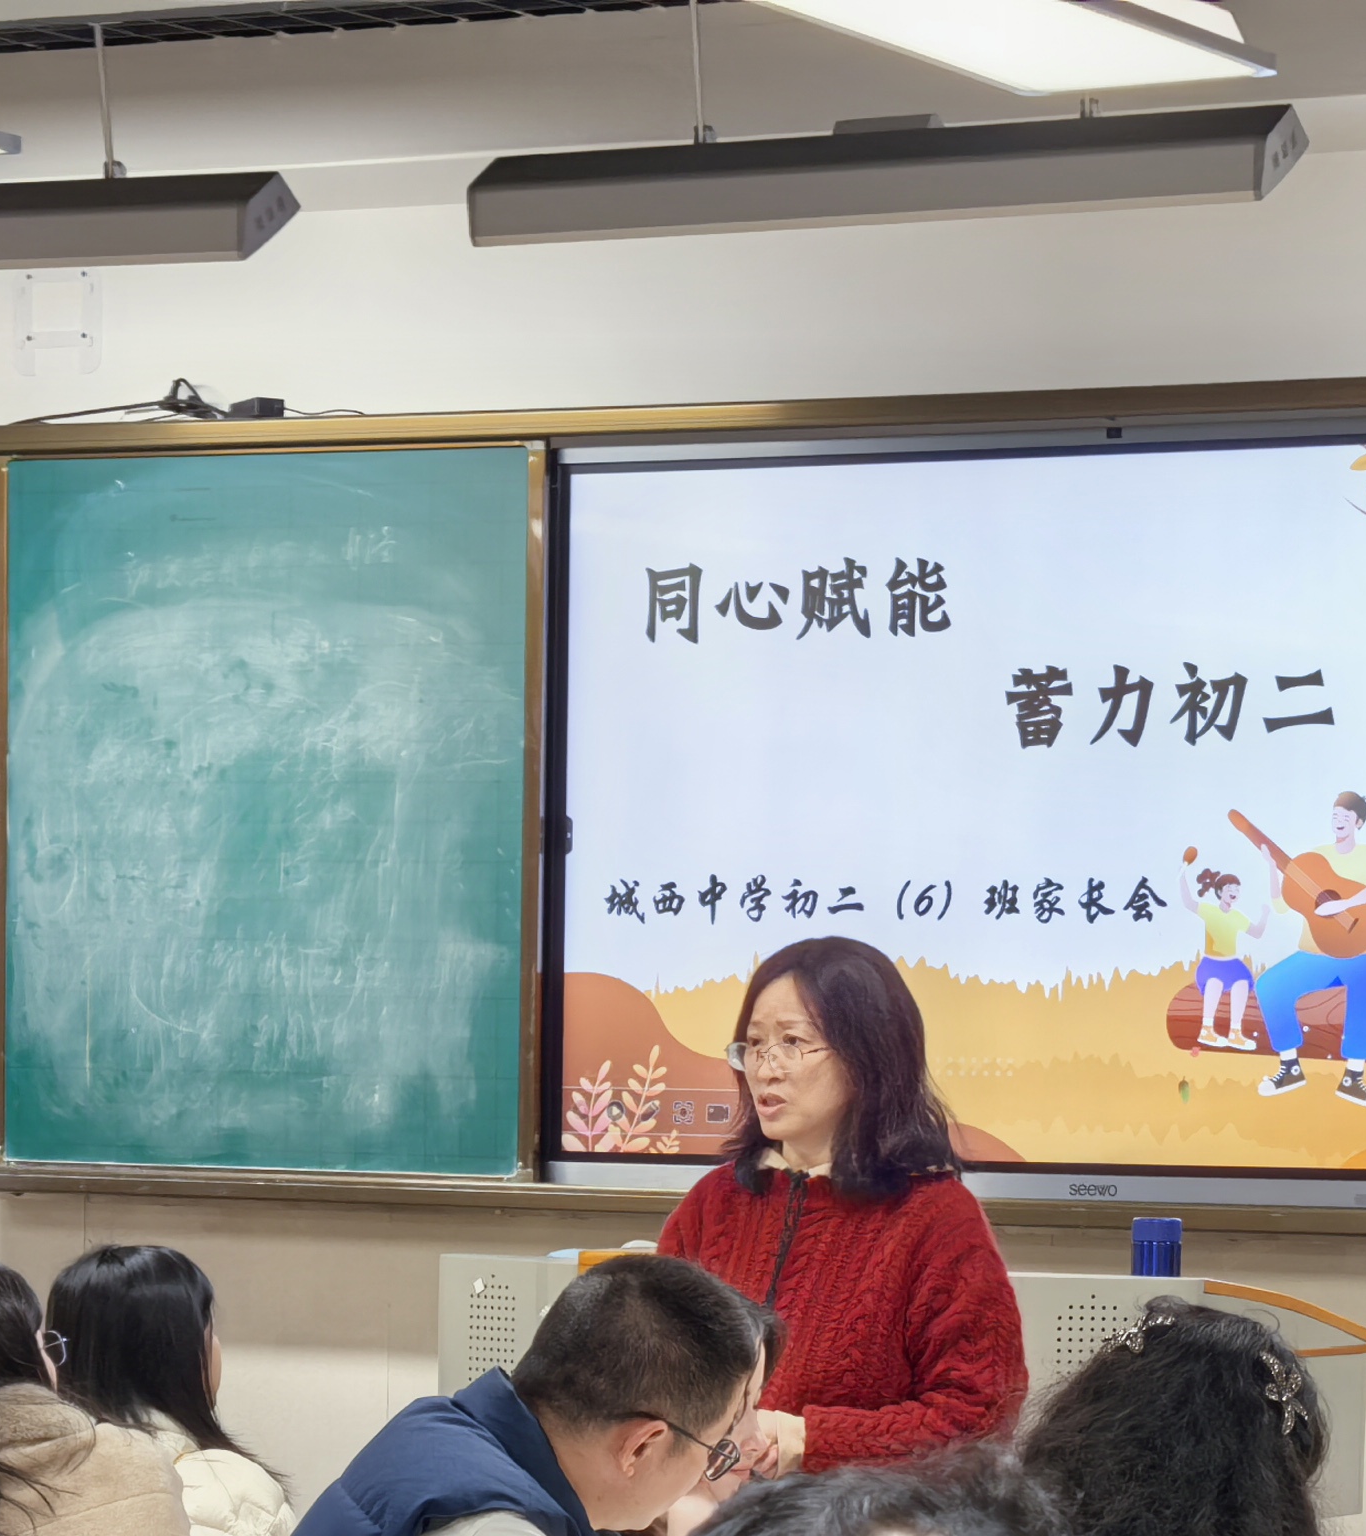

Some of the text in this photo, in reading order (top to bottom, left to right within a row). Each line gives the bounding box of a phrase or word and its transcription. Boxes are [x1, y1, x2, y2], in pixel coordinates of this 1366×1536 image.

[645, 556, 952, 644] 同心赋能
[1004, 661, 1335, 749] 蓄力初二
[1068, 1183, 1118, 1197] seewo
